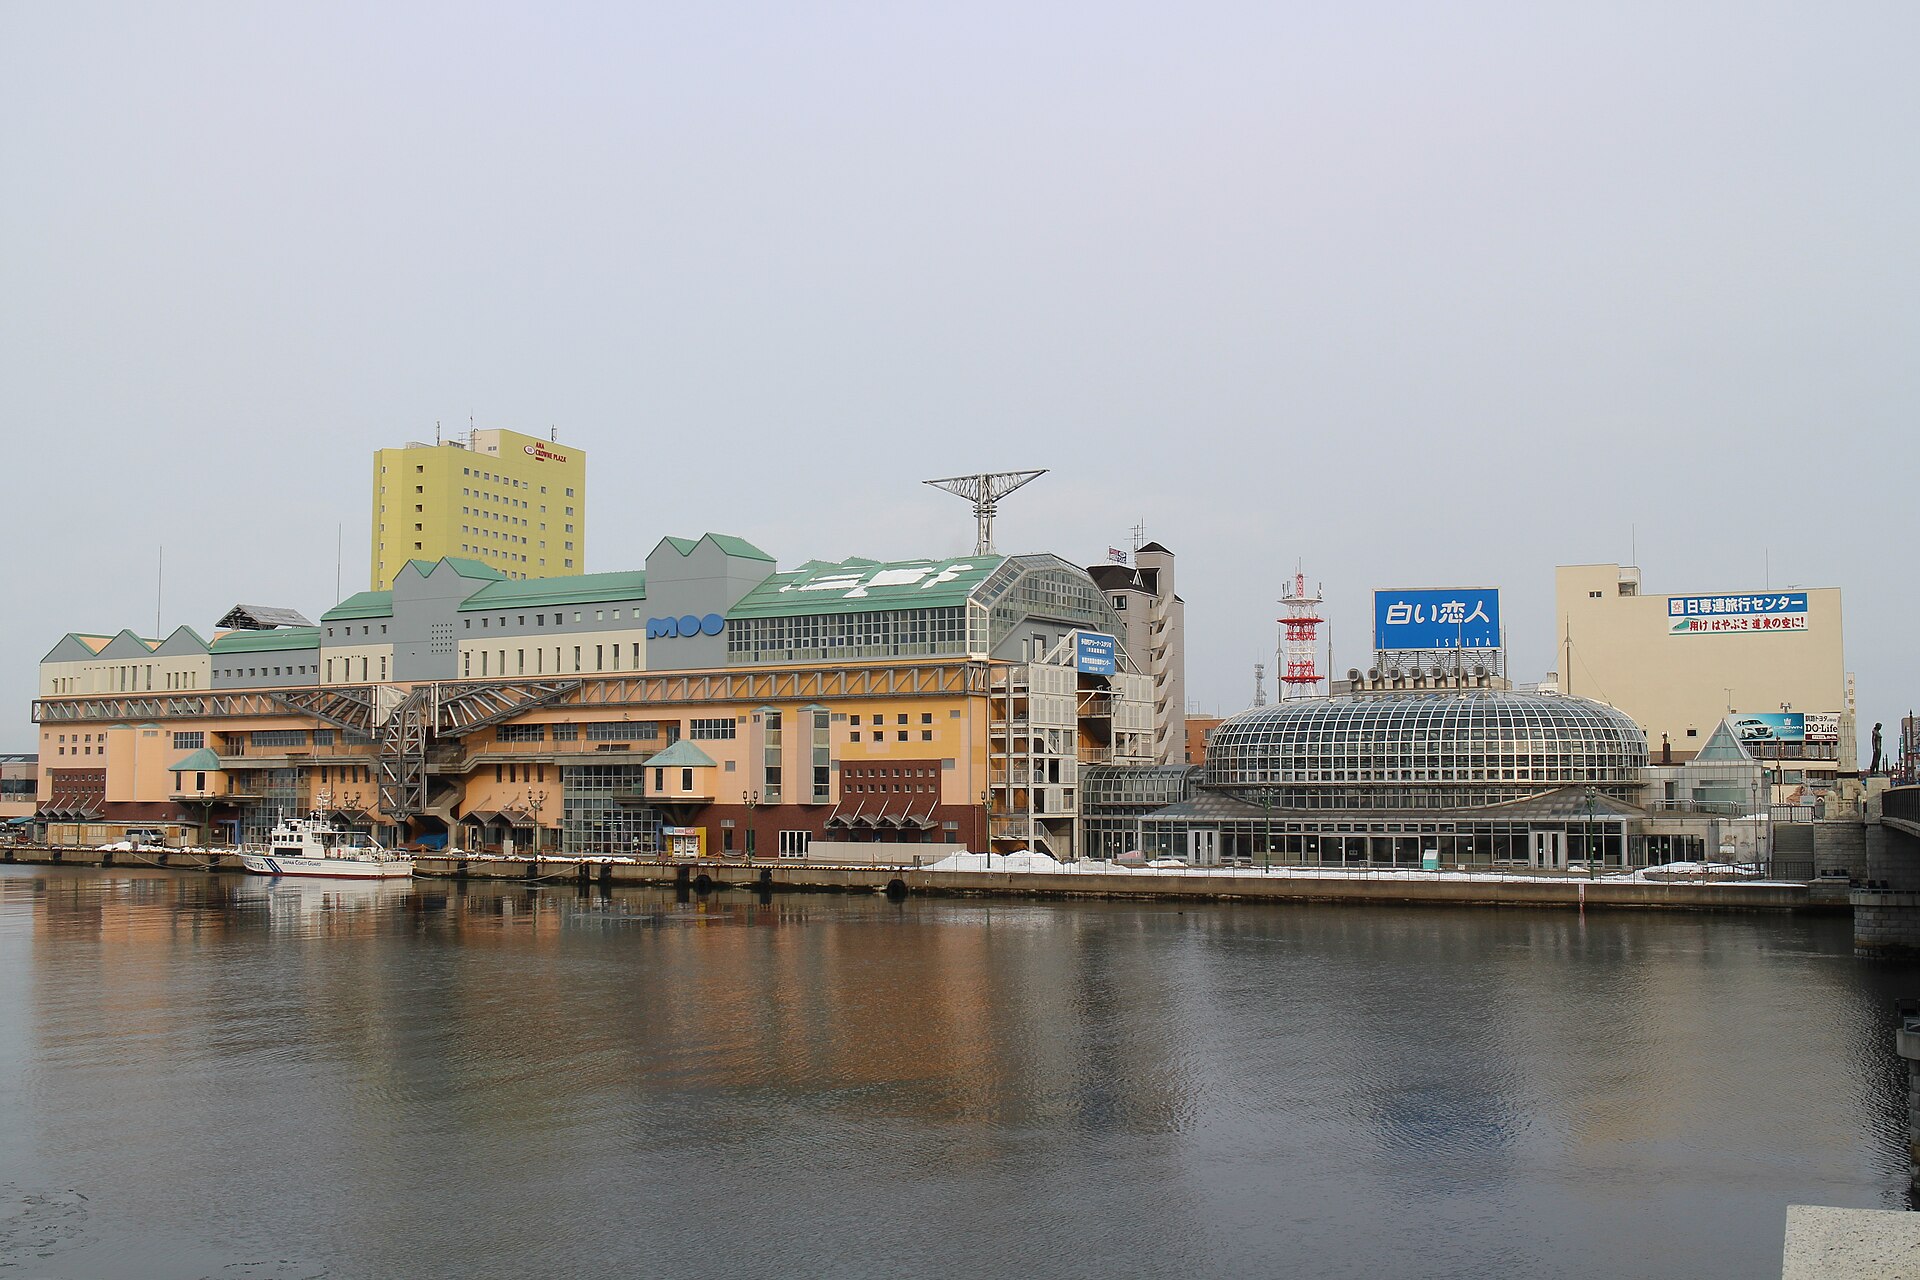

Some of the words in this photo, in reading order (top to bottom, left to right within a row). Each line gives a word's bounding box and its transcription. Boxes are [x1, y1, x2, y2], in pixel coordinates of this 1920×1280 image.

[553, 454, 567, 463] PLAZA
[1687, 596, 1804, 613] 日専連旅行センター
[1386, 600, 1490, 625] 白い恋人
[646, 614, 725, 639] MOO
[1711, 618, 1748, 631] はやぶさ
[1435, 638, 1491, 647] ISHIYA
[1805, 723, 1838, 733] DO-Life
